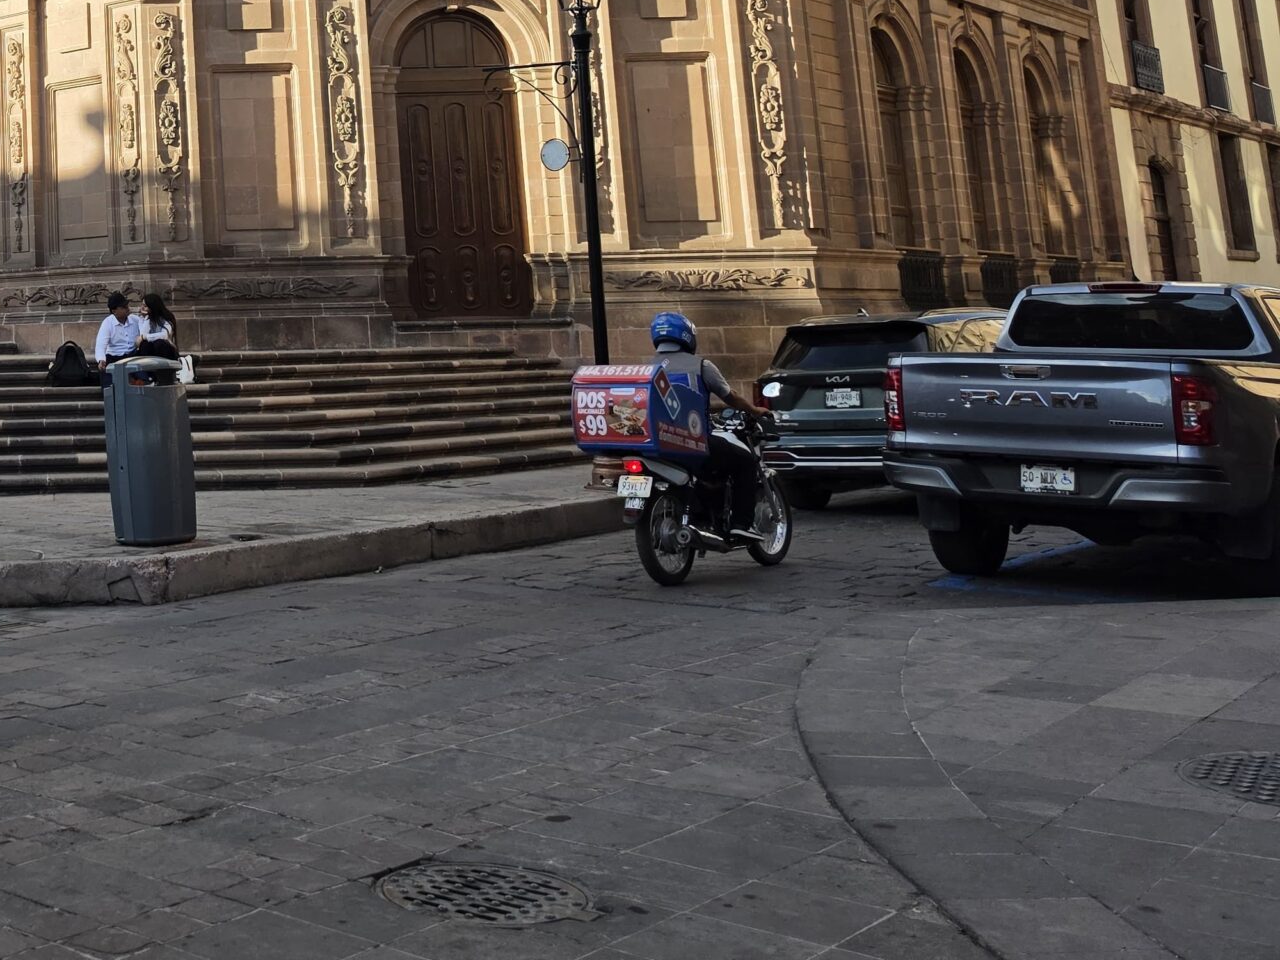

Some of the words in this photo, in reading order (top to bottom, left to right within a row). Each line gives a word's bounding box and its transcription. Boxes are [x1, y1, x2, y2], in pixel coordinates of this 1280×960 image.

[577, 391, 606, 409] DOS
[960, 388, 1099, 409] RAM
[579, 414, 607, 436] $99
